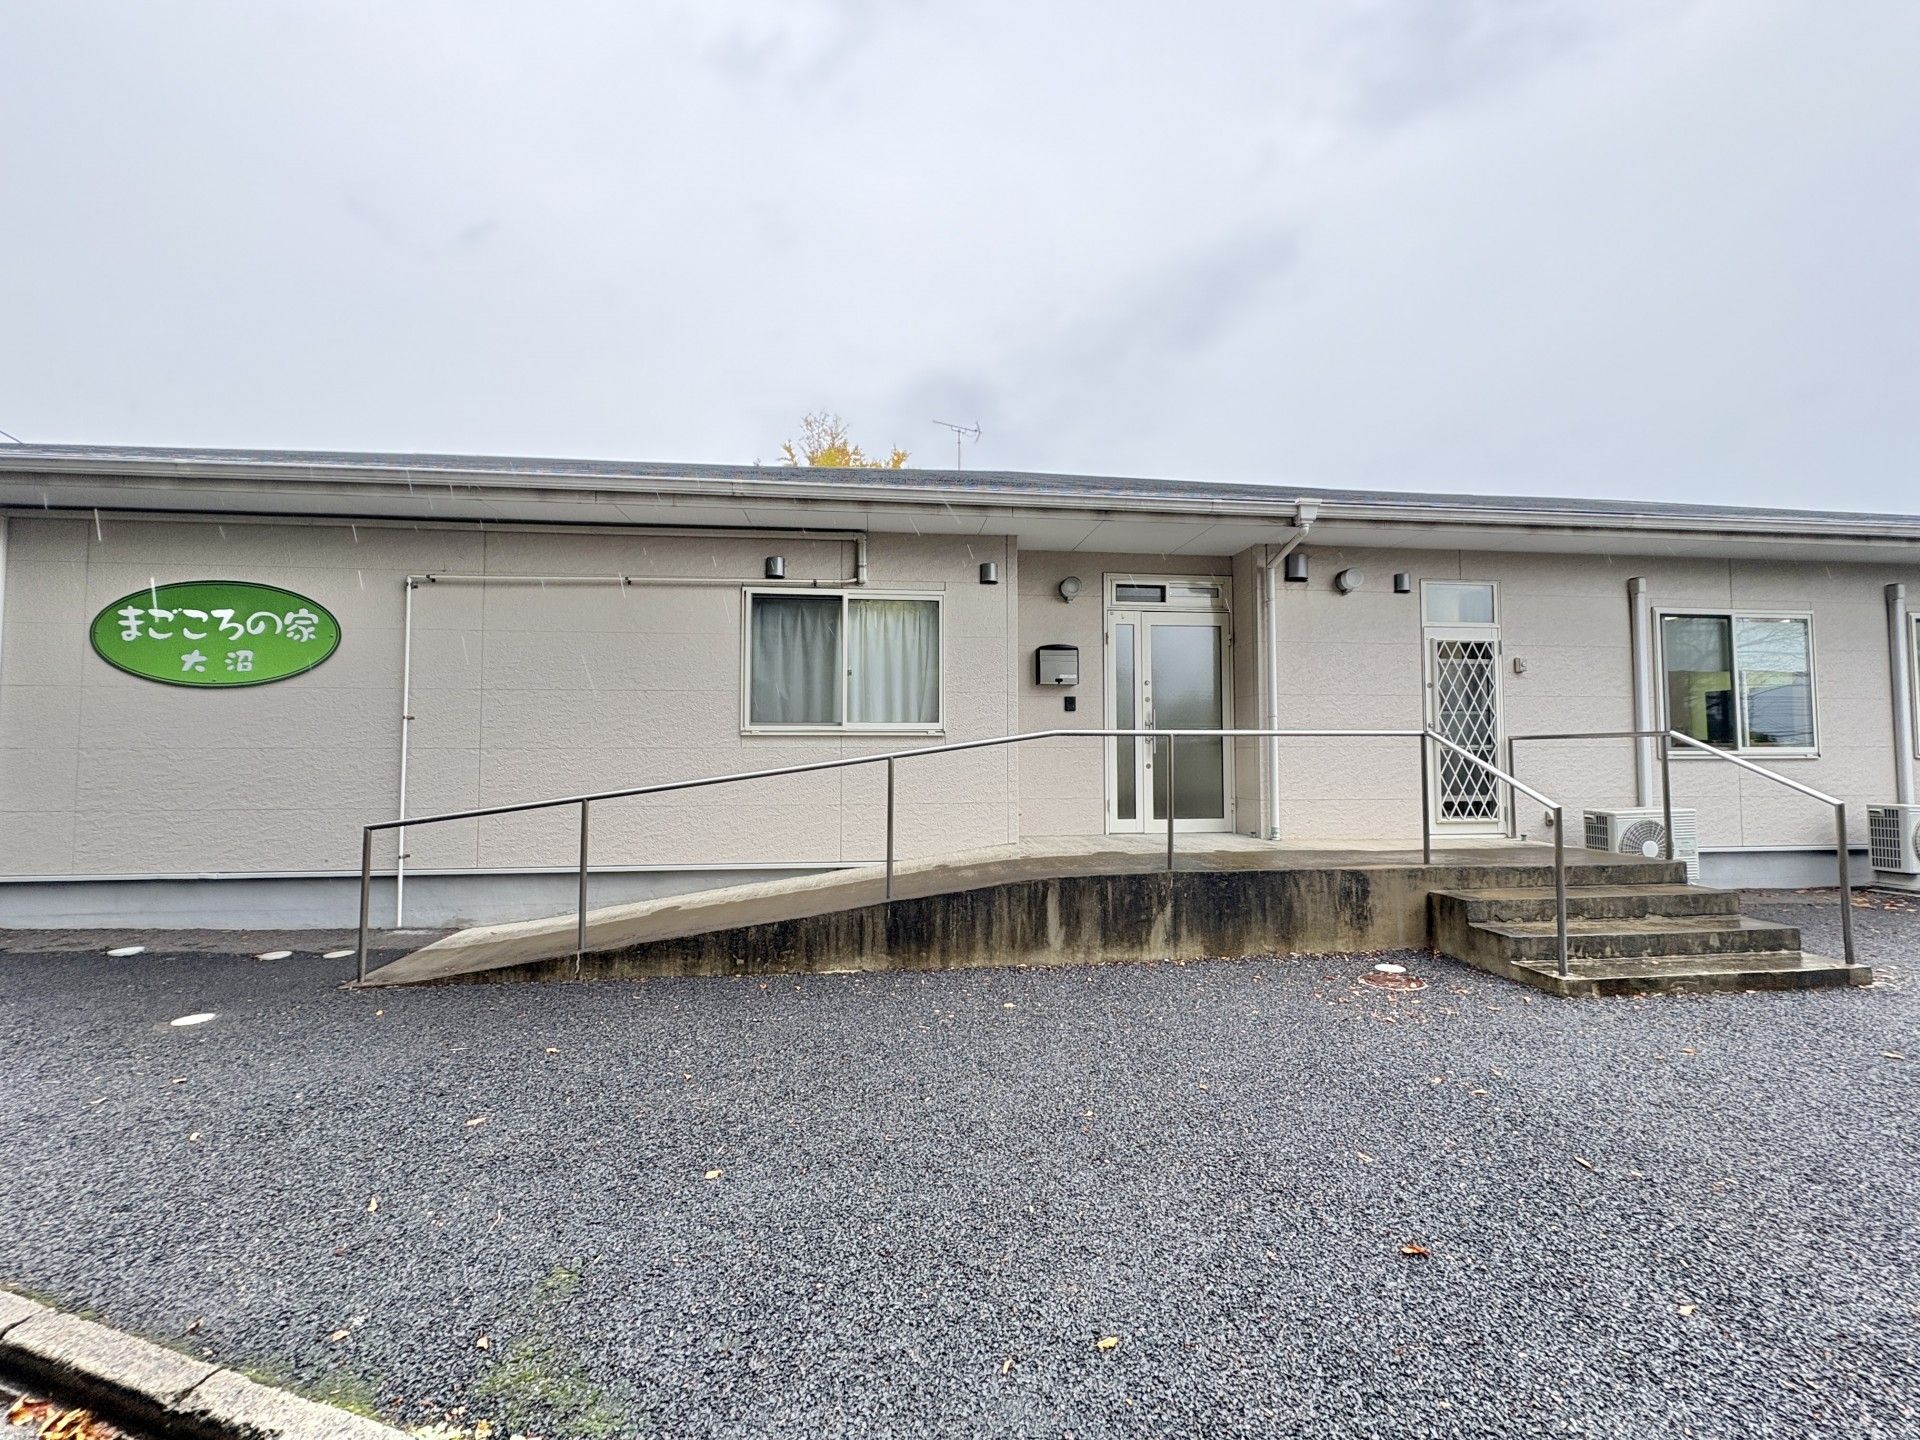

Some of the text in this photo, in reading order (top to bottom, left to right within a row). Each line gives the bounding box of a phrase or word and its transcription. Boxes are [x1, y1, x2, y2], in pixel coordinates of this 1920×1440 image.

[117, 605, 319, 643] まごころの家
[180, 649, 254, 673] 大沼
